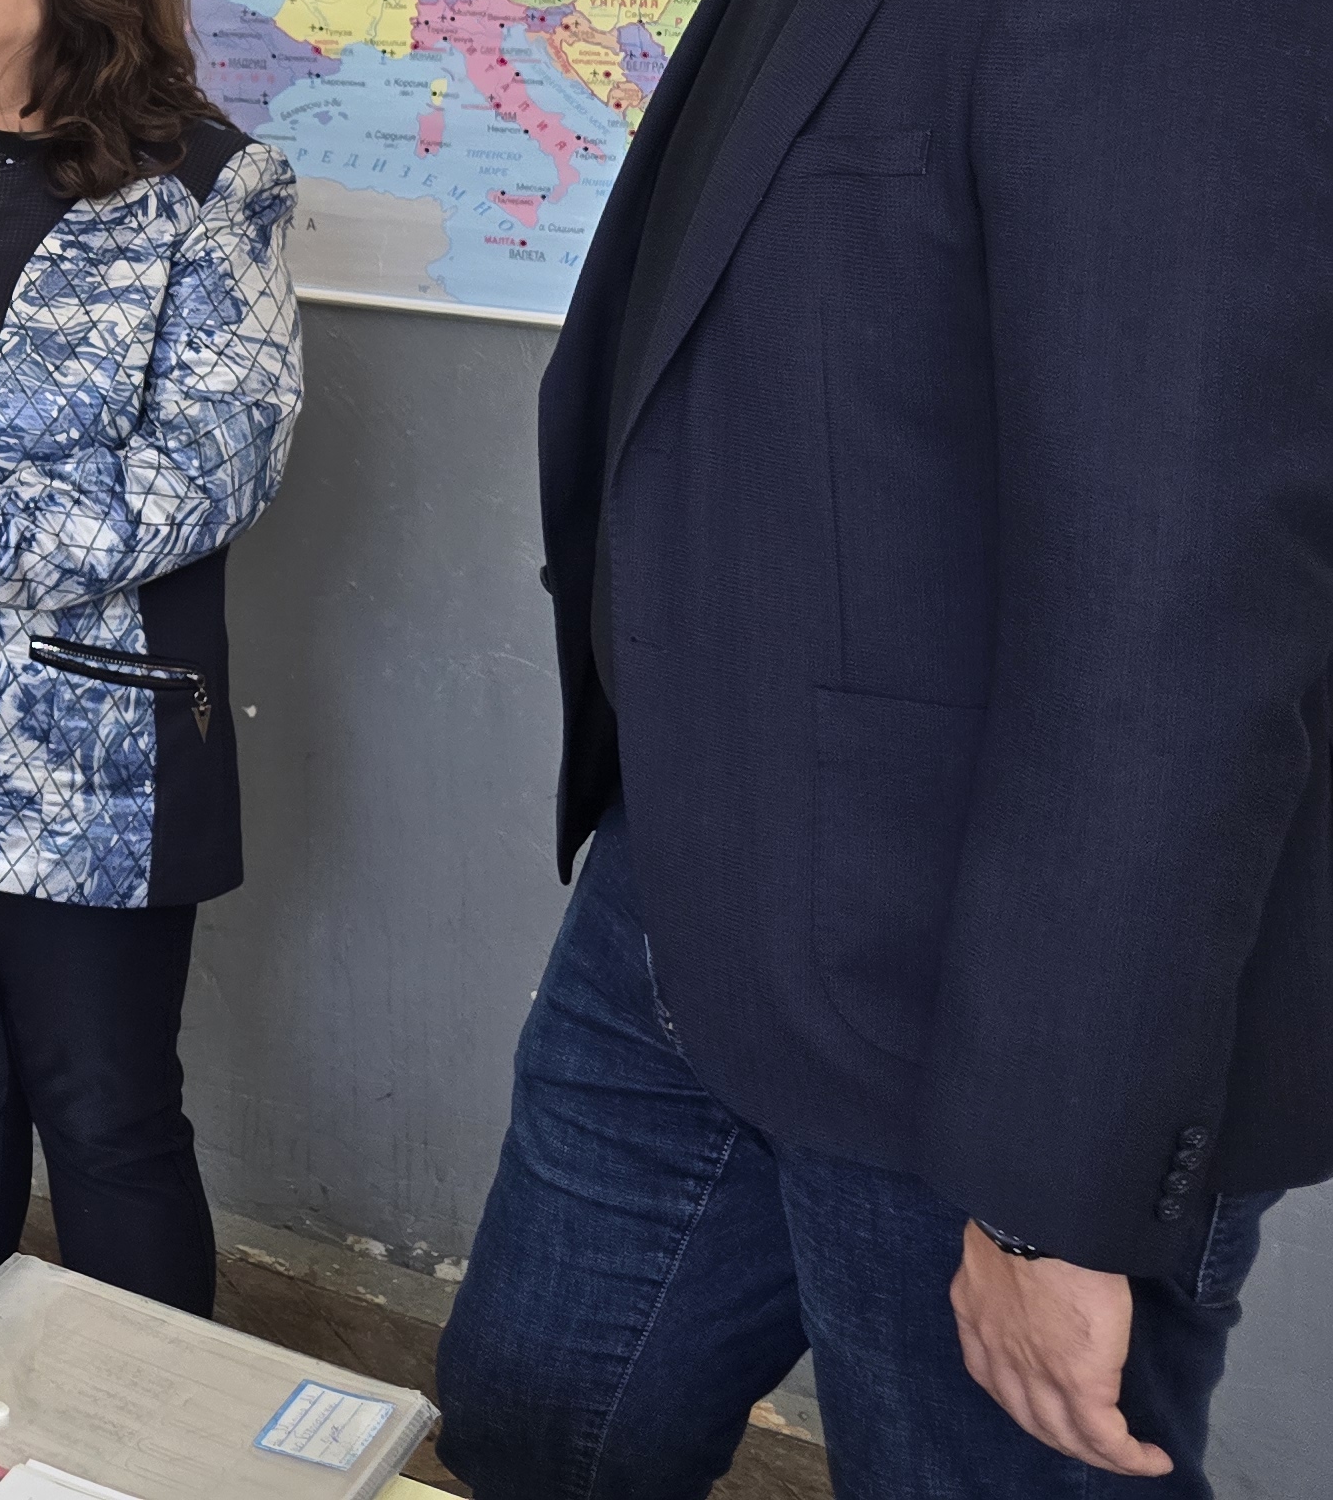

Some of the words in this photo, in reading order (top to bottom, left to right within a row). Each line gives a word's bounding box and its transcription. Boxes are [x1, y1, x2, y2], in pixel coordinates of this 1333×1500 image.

[228, 57, 268, 70] МАДРИД
[495, 111, 517, 122] РИМ
[466, 150, 523, 162] ТИРЕНСКО
[479, 167, 509, 177] МОРЕ
[484, 235, 516, 246] МАЛТА
[509, 250, 547, 262] ВАЛЕТА
